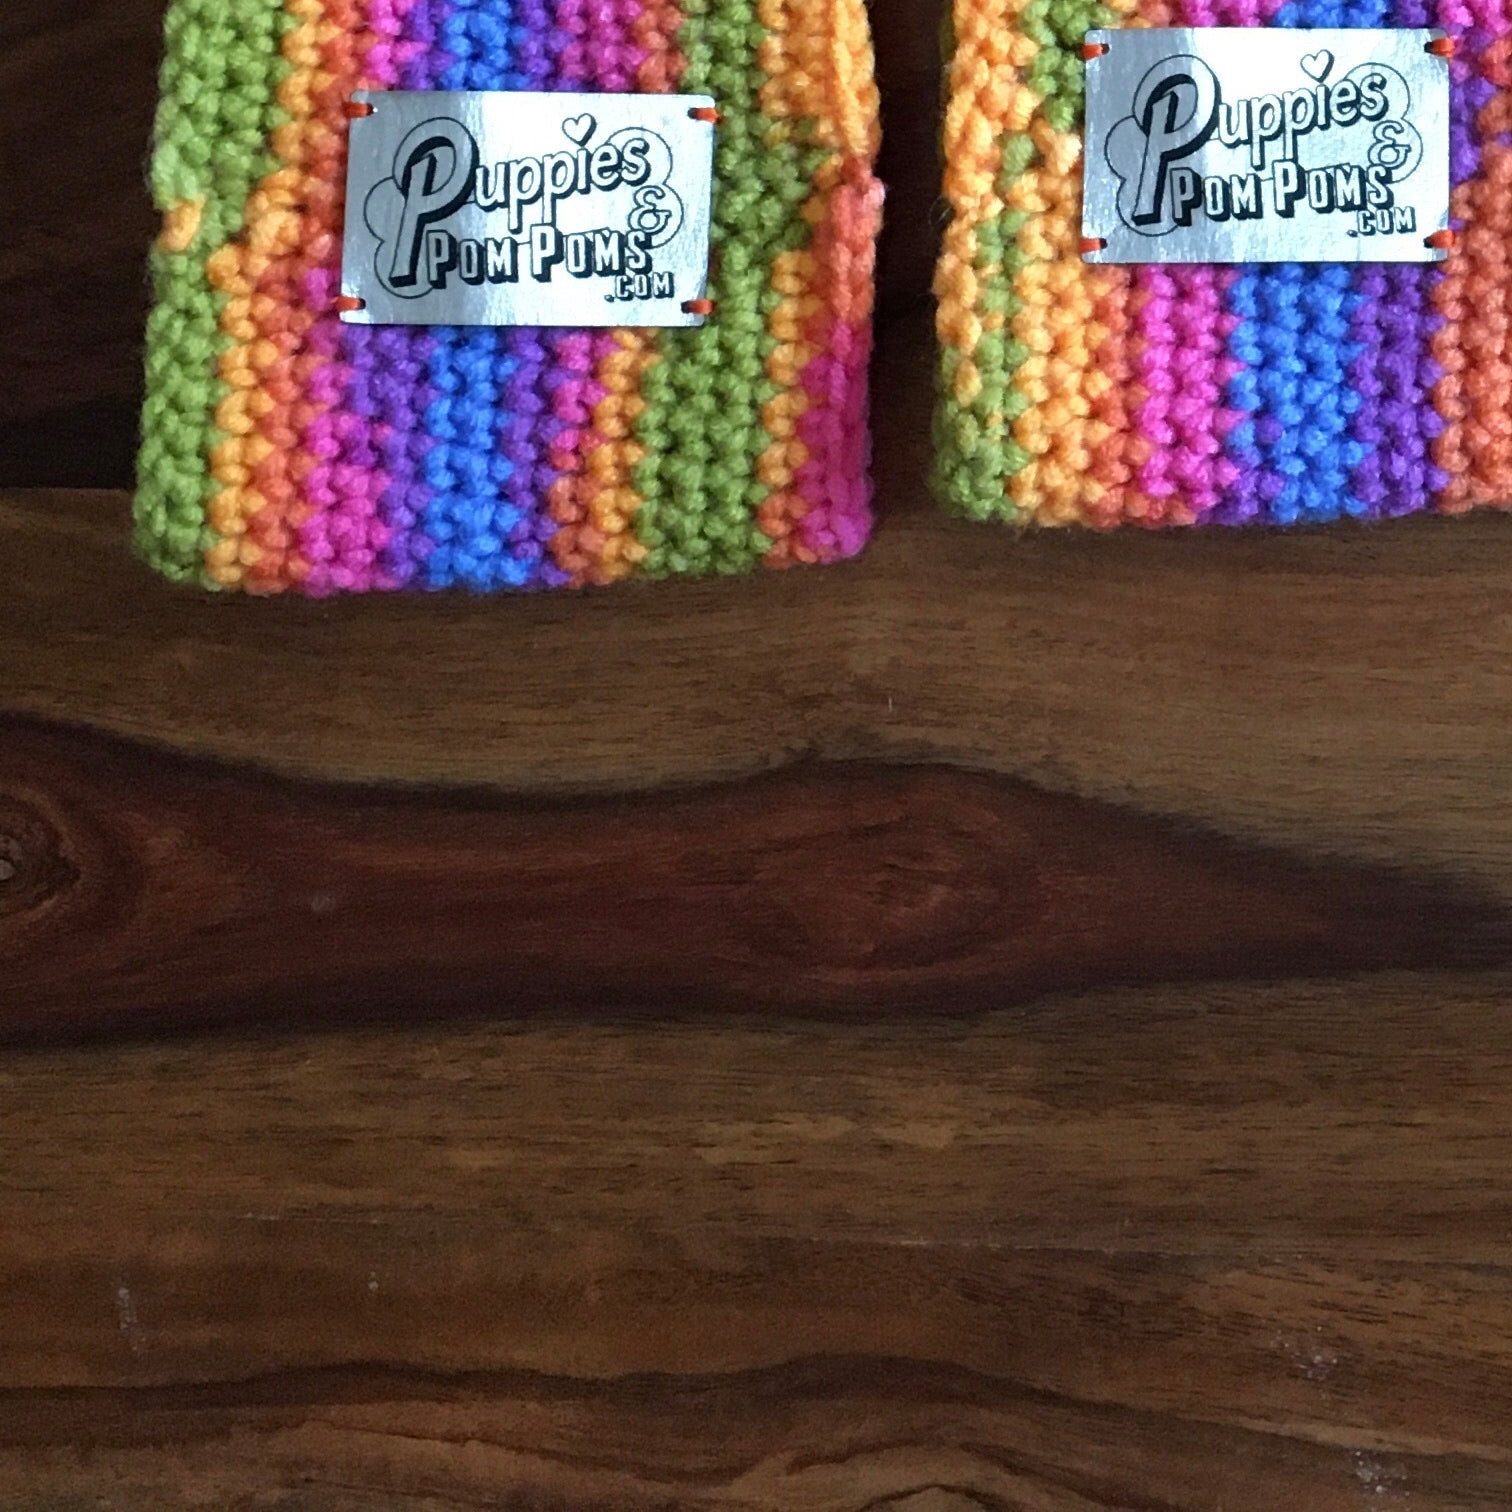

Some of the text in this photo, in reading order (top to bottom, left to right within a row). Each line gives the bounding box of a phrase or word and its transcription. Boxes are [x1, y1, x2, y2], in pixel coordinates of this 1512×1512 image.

[1132, 49, 1389, 225] Puppies
[1368, 120, 1411, 169] &
[389, 113, 651, 288] Puppies
[628, 185, 671, 234] &
